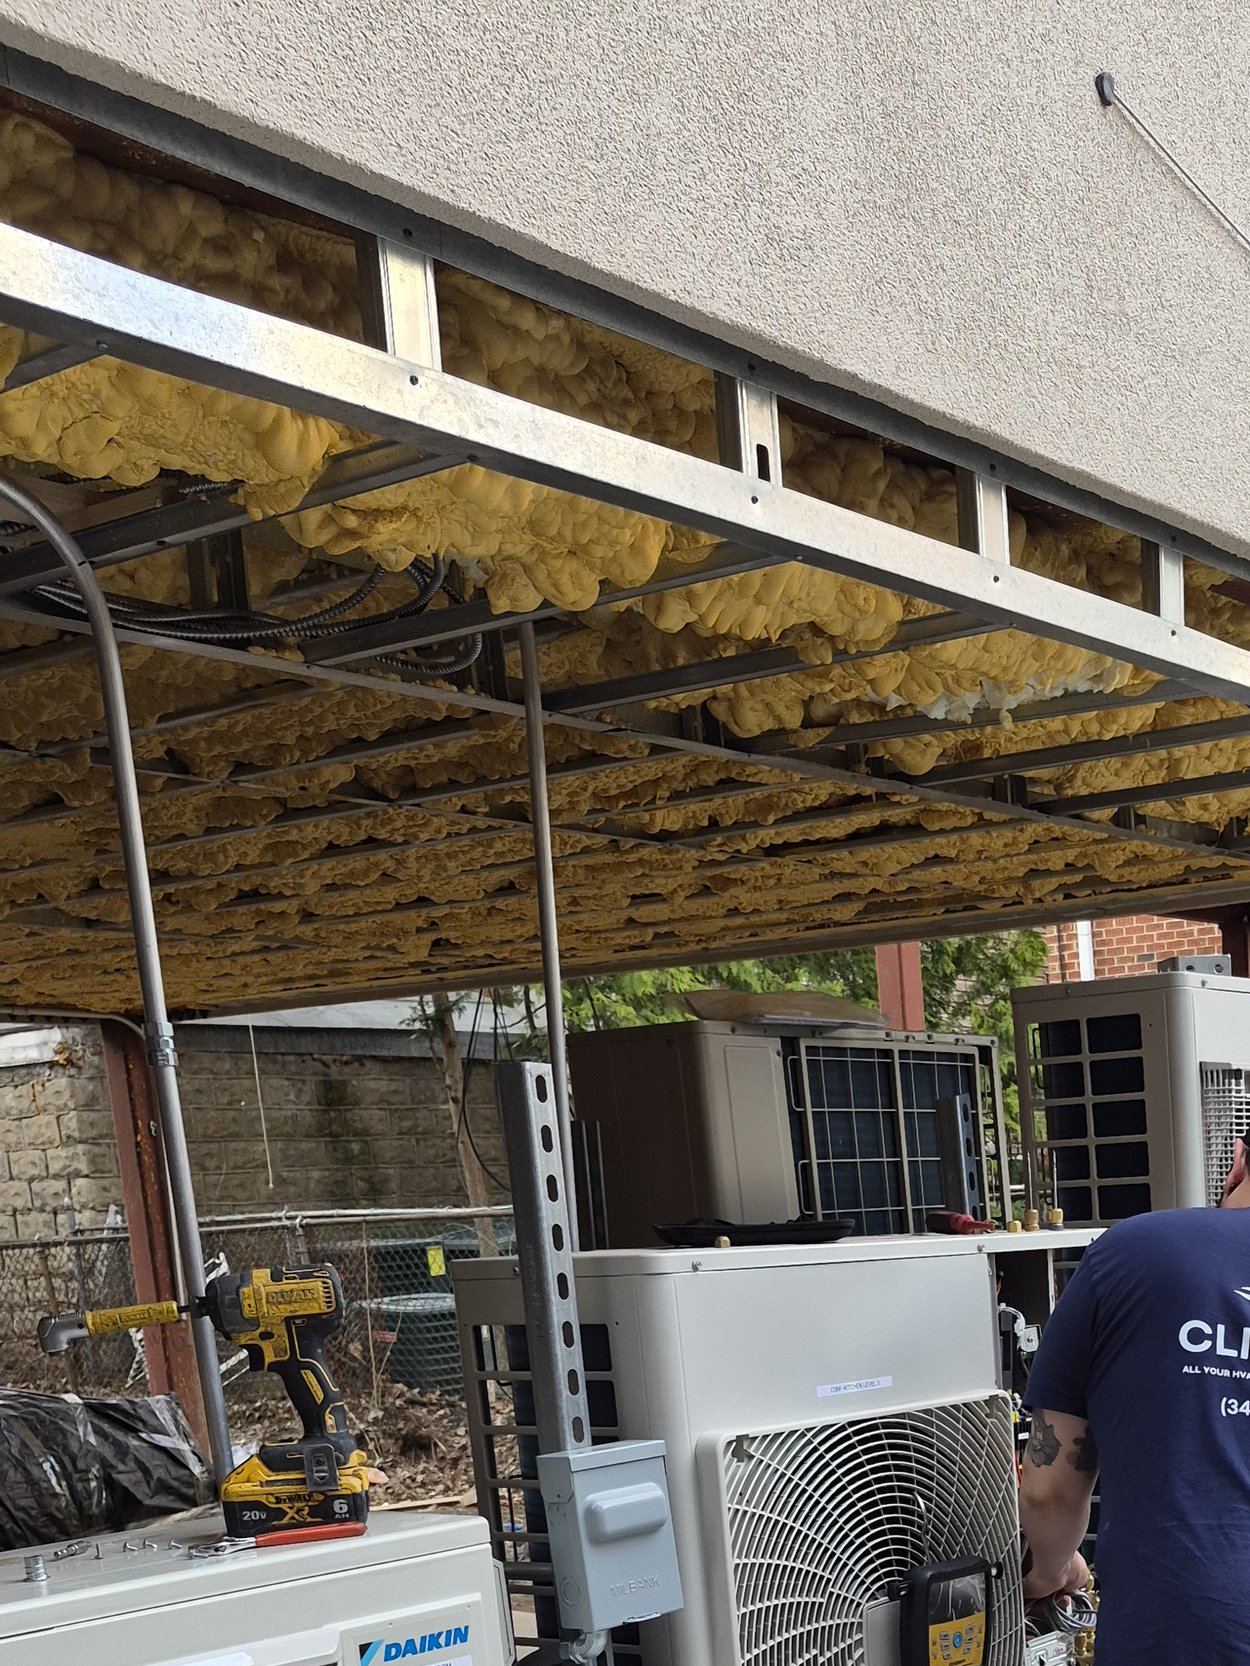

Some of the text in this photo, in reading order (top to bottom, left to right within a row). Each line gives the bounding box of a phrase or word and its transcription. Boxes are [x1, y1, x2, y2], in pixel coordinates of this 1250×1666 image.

[1182, 1365, 1202, 1375] ALL
[1203, 1366, 1231, 1378] YOUR
[333, 1498, 349, 1514] 6
[609, 1574, 661, 1596] MILBANK
[383, 1624, 470, 1663] DAIKIN
